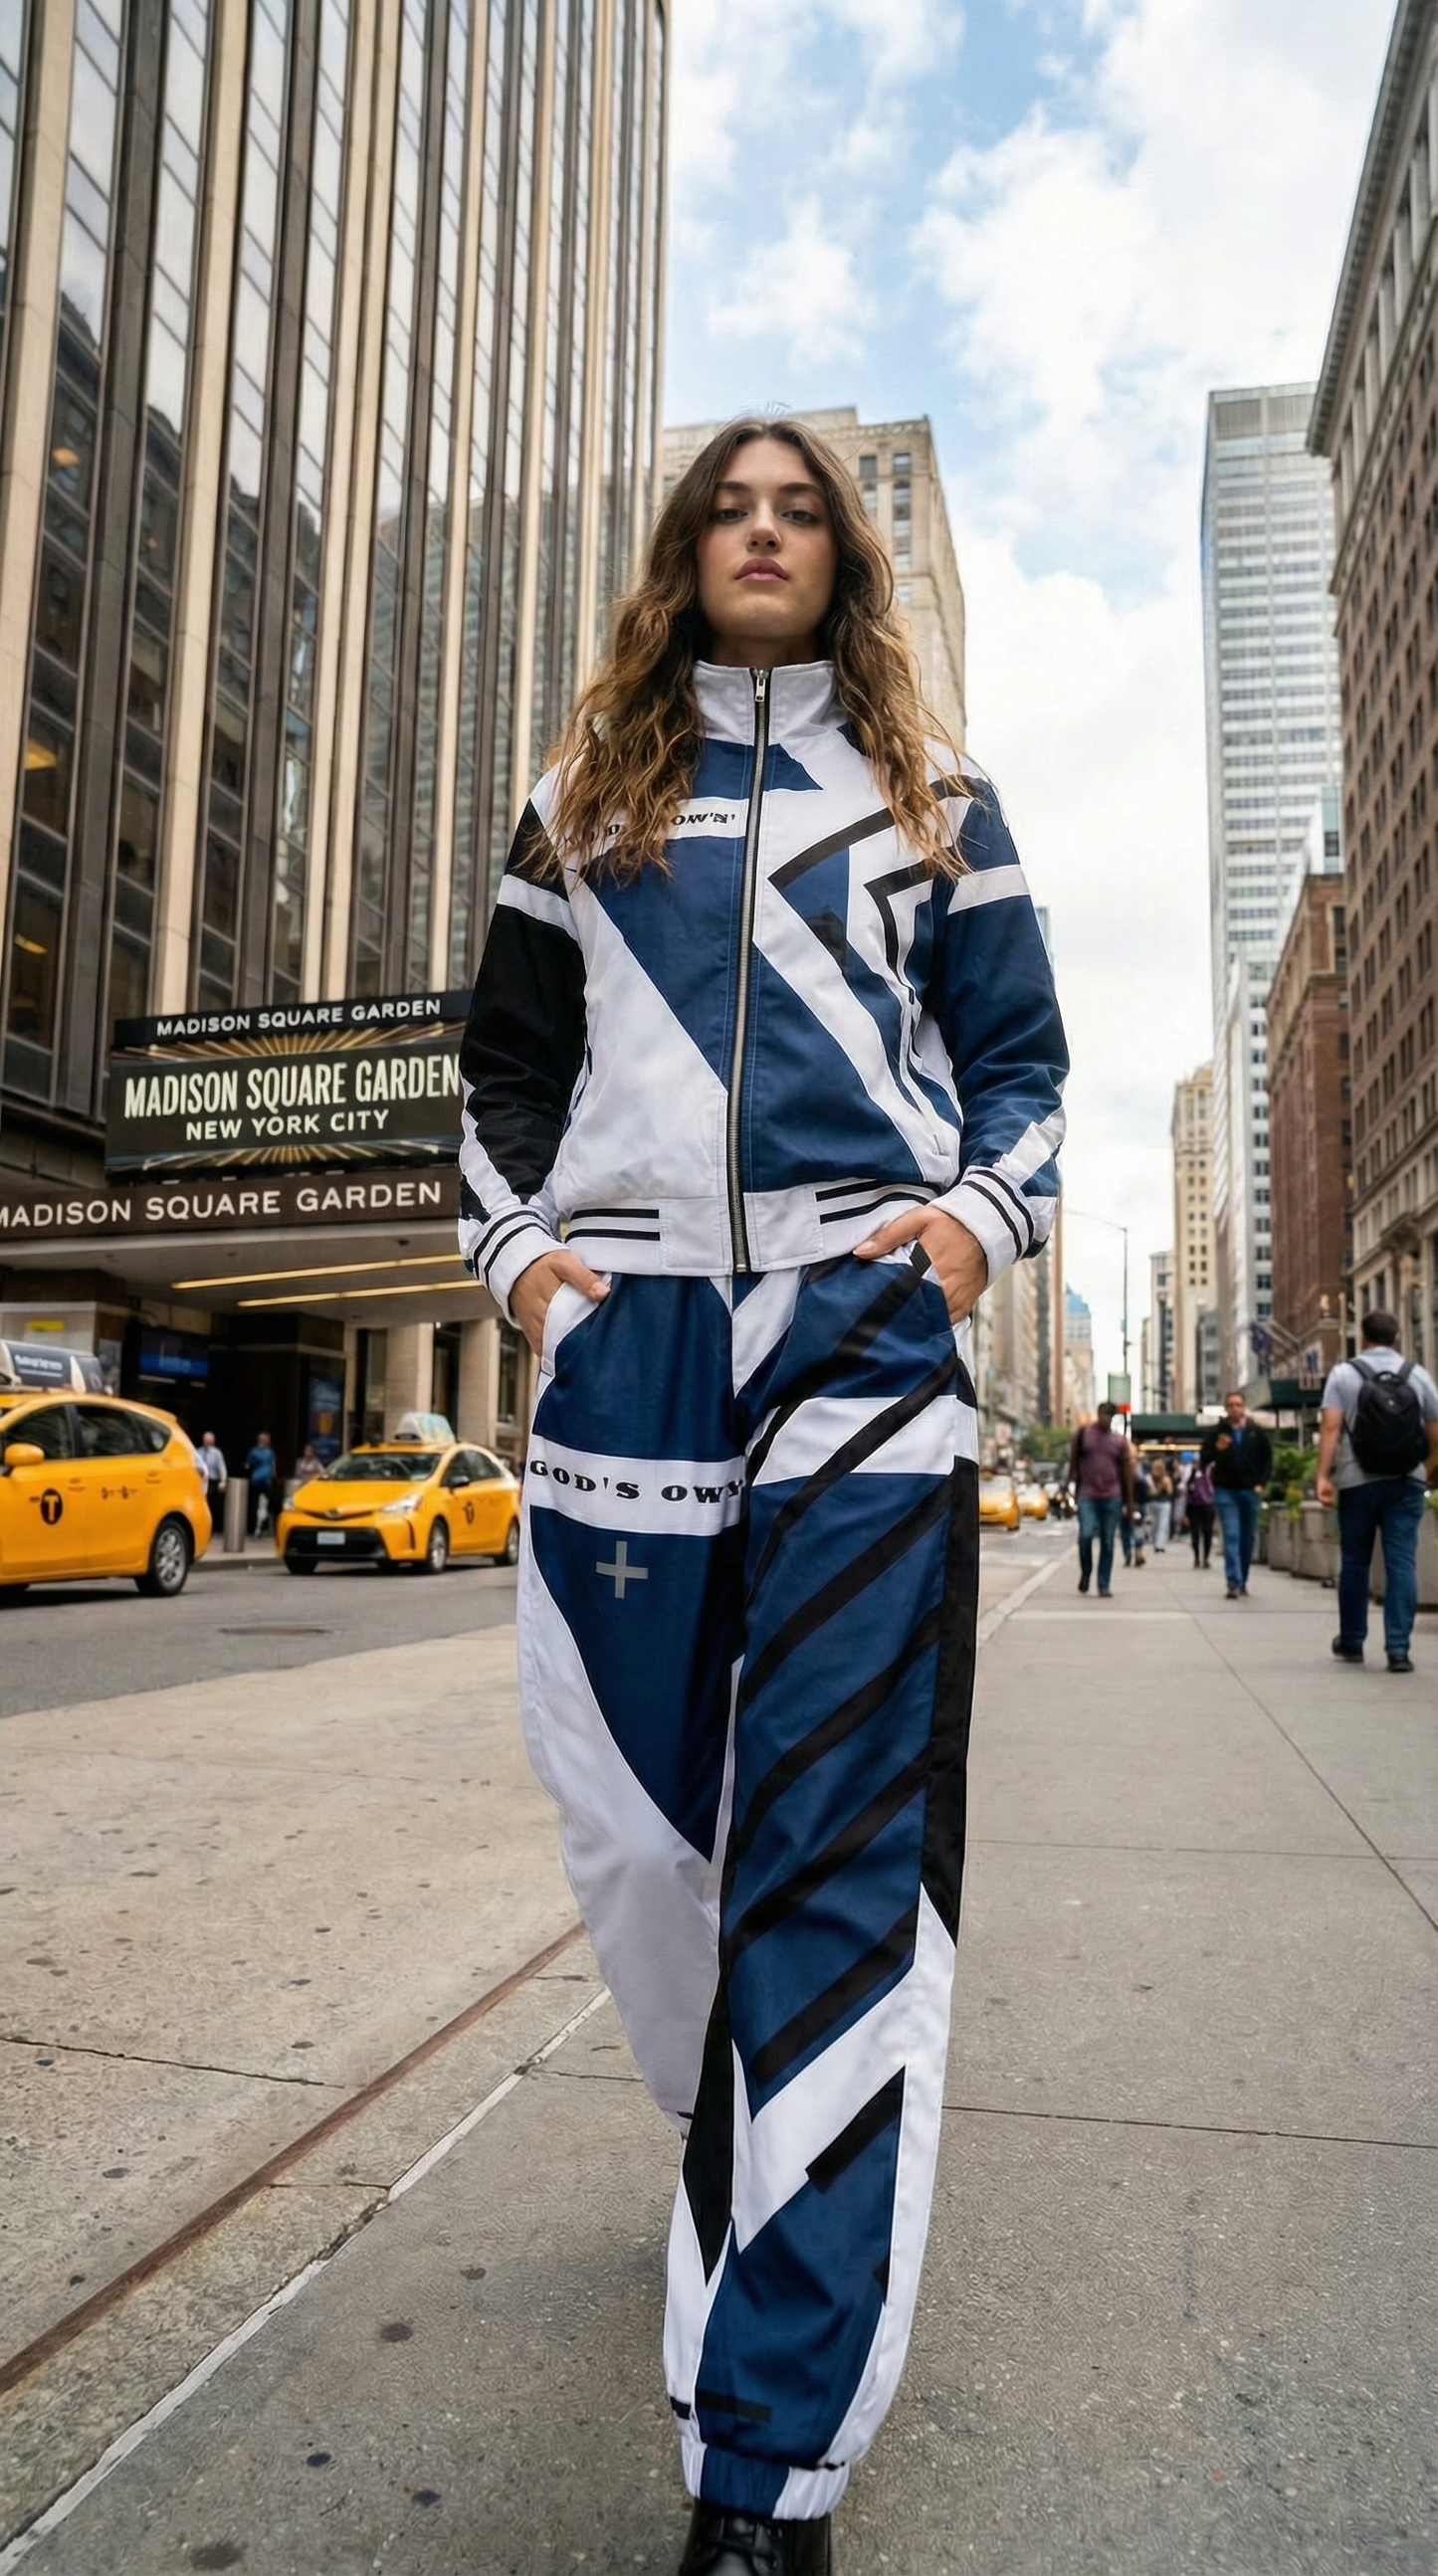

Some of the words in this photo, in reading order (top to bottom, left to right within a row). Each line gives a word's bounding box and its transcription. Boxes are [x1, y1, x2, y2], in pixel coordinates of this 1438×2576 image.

[156, 1015, 250, 1037] MADISON
[258, 1007, 343, 1029] SQUARE
[351, 999, 441, 1021] GARDEN
[124, 1070, 238, 1119] MADISON
[246, 1062, 347, 1114] SQUARE
[355, 1054, 460, 1102] GARDEN
[186, 1118, 242, 1141] NEW
[251, 1113, 319, 1136] YORK
[329, 1108, 389, 1132] CITY
[145, 1191, 281, 1221] SQUARE
[296, 1181, 442, 1212] GARDEN
[529, 1460, 641, 1499] GOD'S
